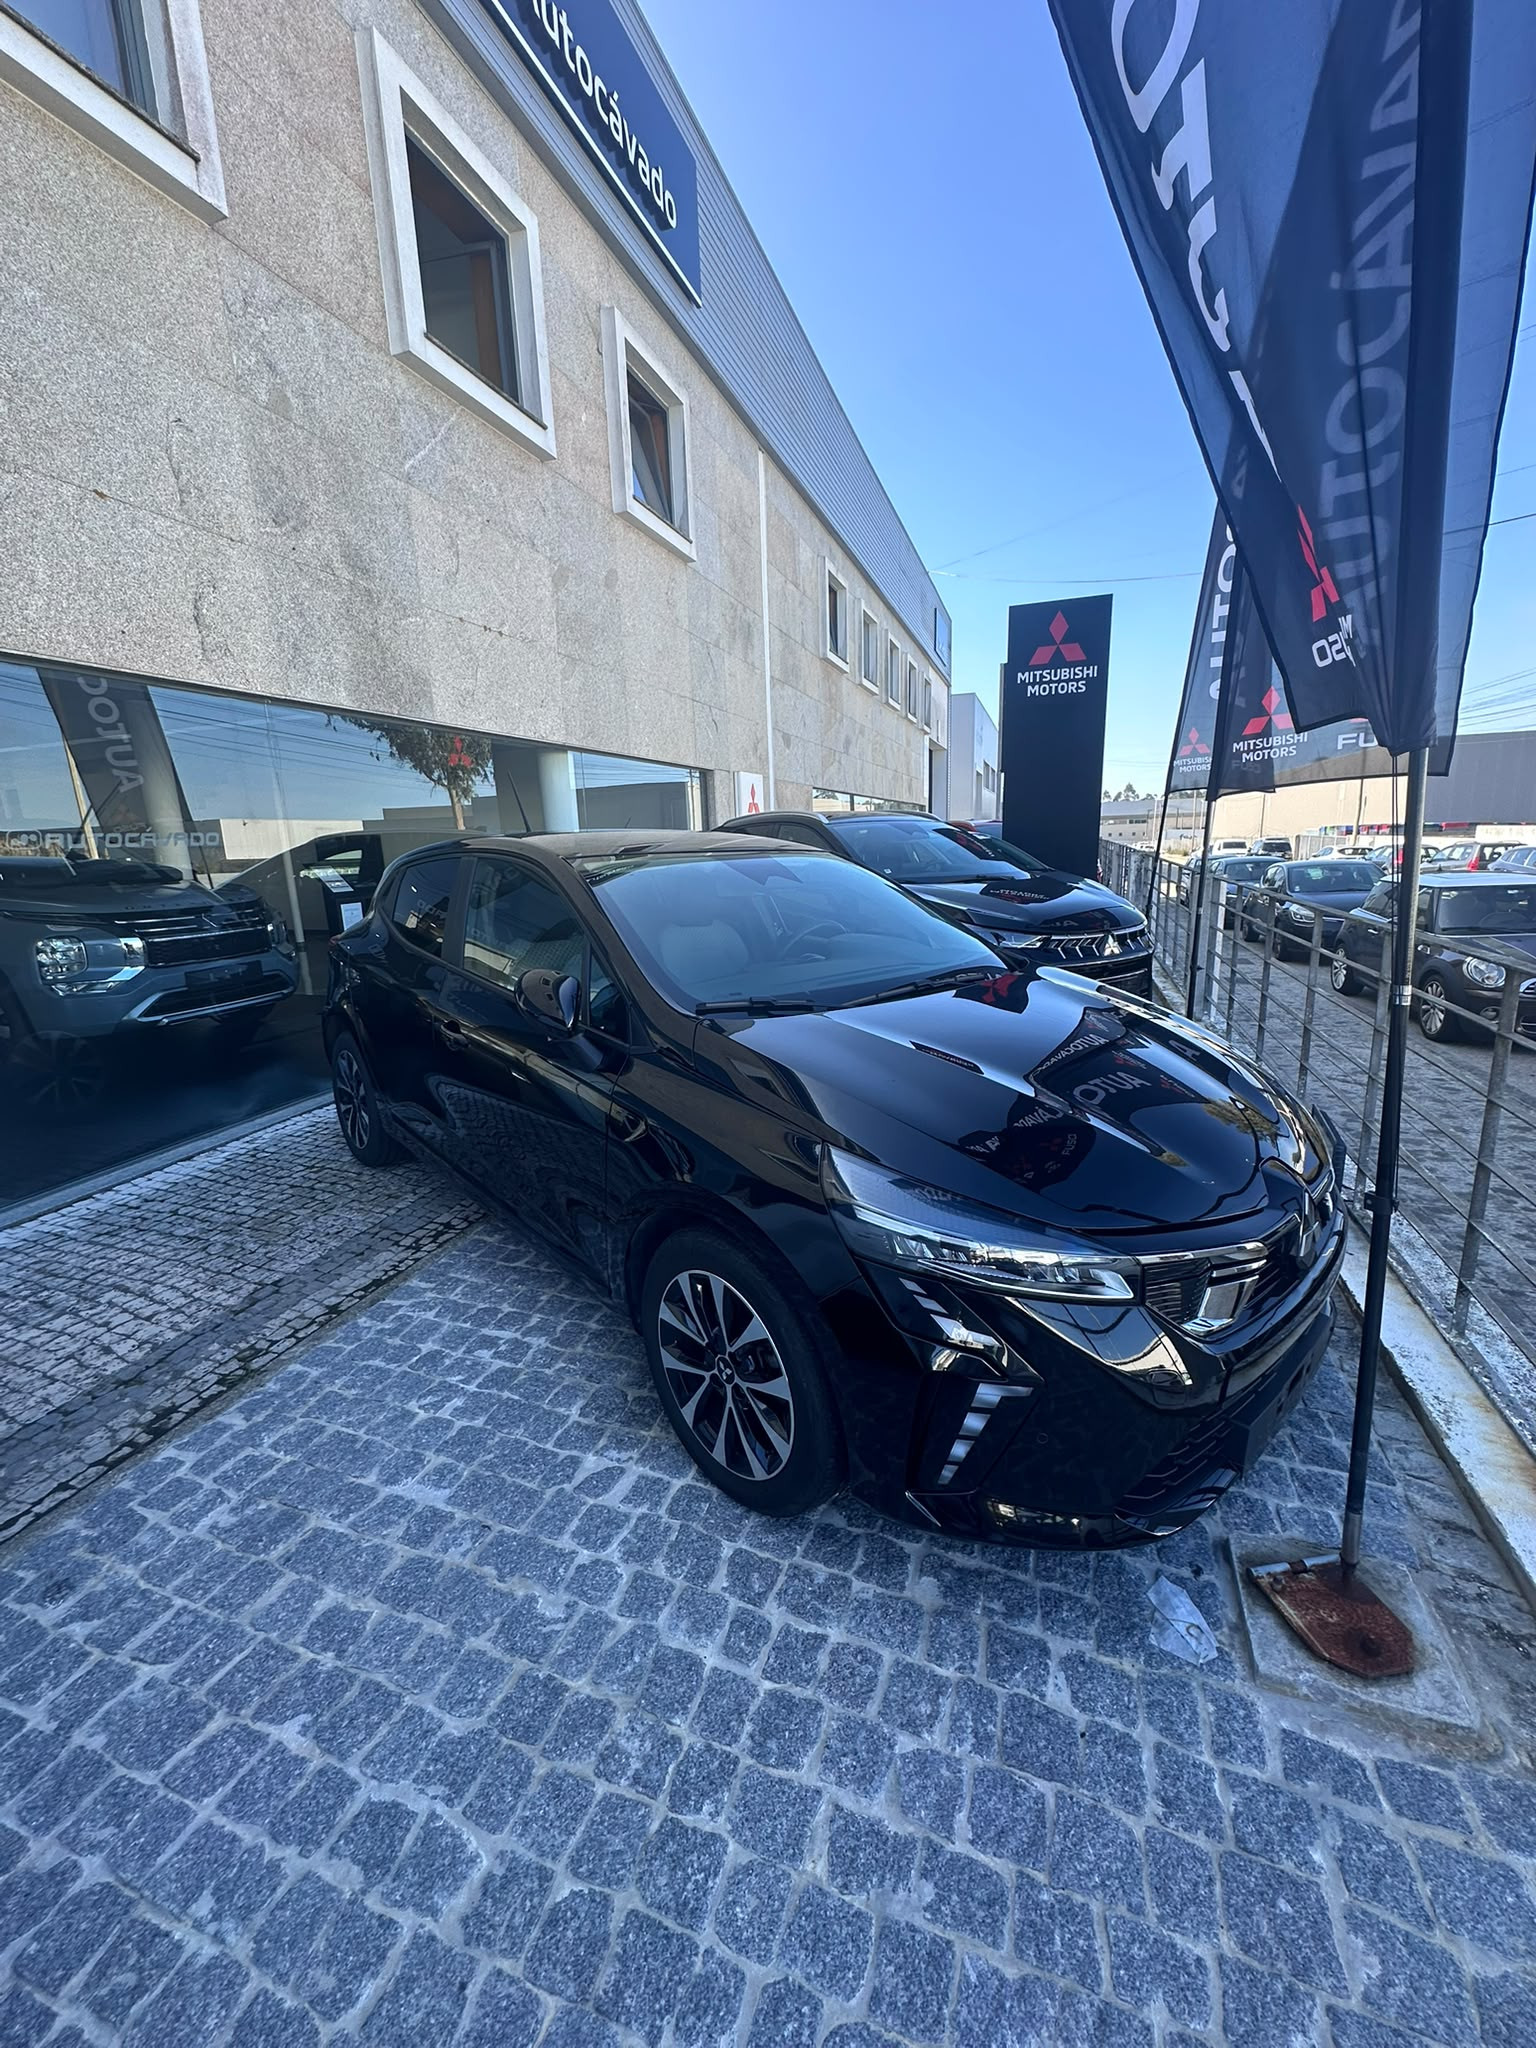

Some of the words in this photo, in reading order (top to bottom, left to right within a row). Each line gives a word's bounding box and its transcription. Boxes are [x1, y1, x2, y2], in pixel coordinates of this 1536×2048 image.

[533, 0, 678, 229] utocávado
[1017, 665, 1098, 684] MITSUBISHI
[1027, 681, 1087, 697] MOTORS
[1232, 732, 1308, 753] MITSUBISHI
[1173, 756, 1212, 768] MITSUBIS
[1242, 746, 1297, 762] MOTORS
[1179, 763, 1212, 773] MOTORS
